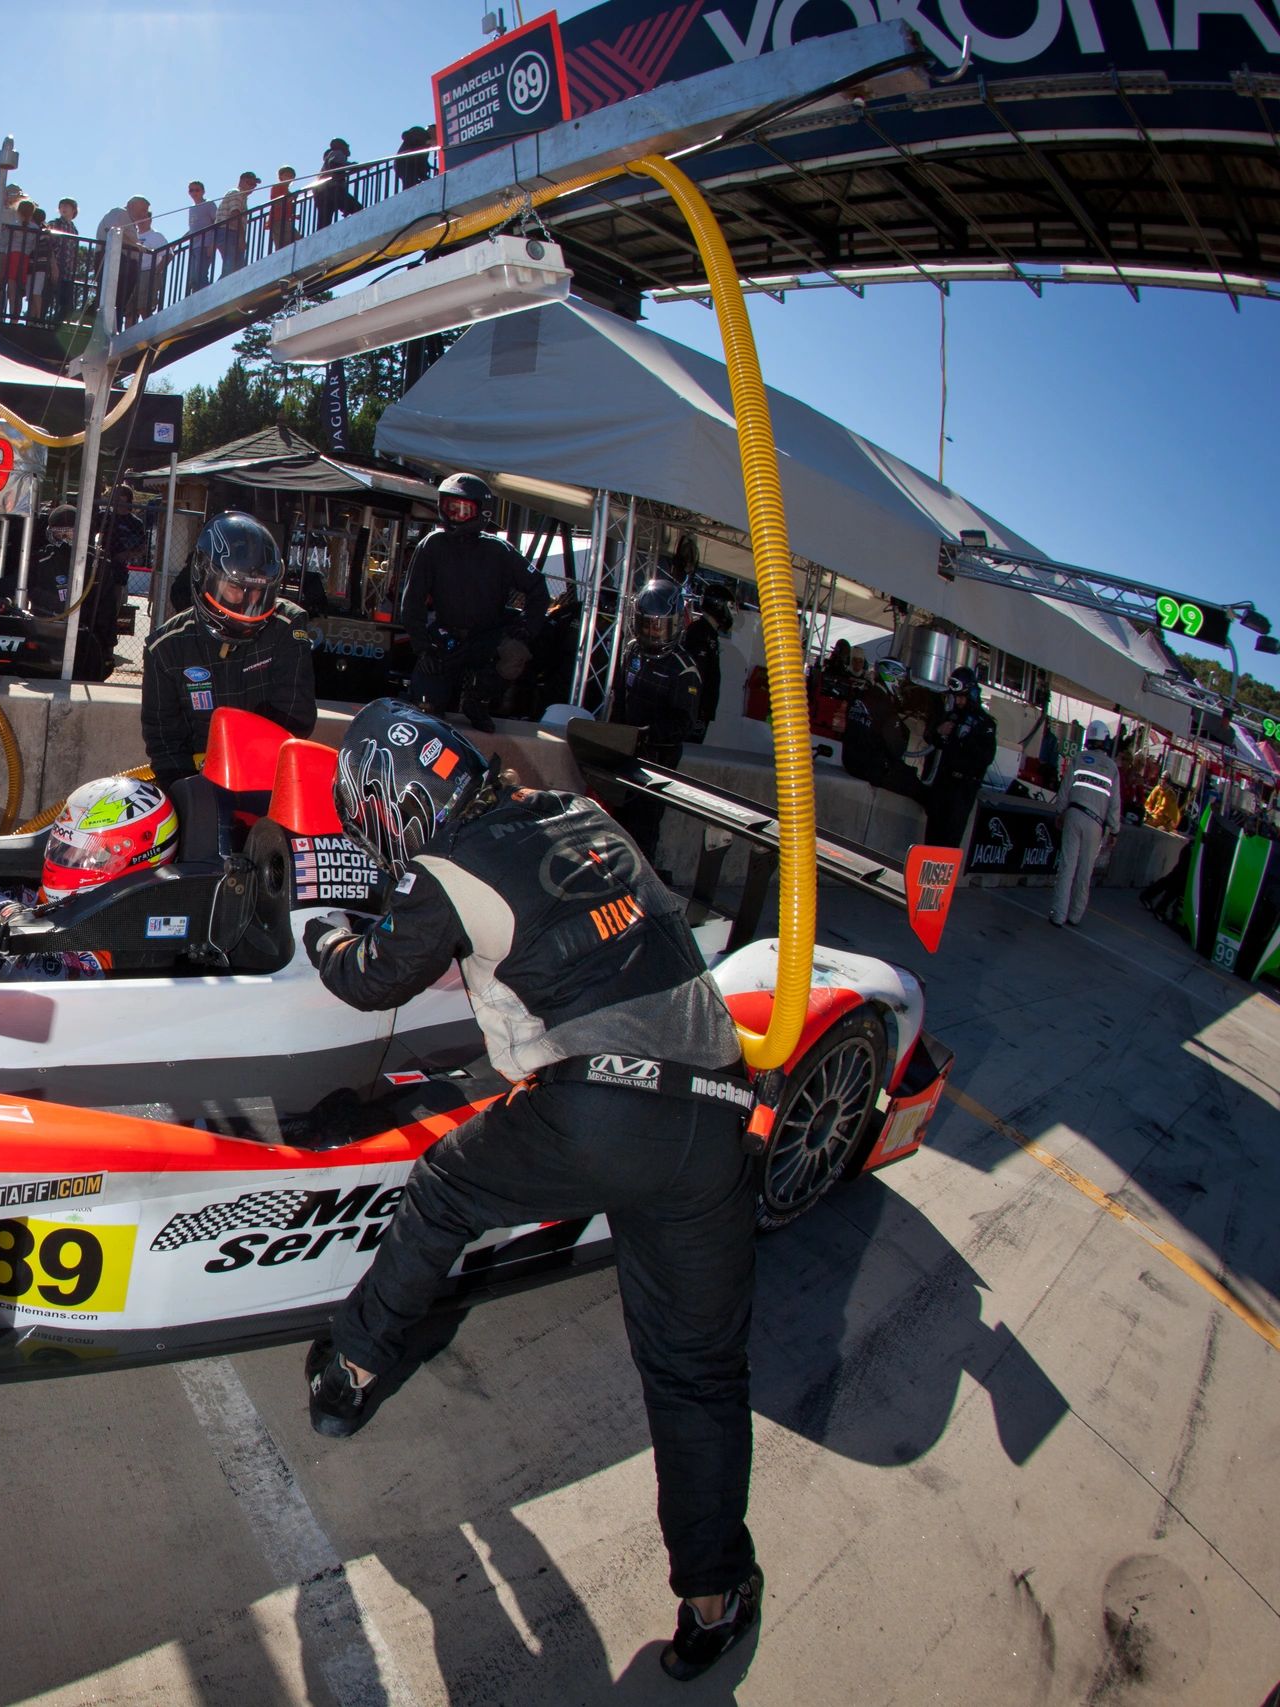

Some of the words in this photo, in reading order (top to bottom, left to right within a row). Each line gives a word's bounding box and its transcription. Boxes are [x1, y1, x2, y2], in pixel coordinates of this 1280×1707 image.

[452, 63, 505, 100] MARCELLI
[513, 62, 543, 105] 89
[457, 83, 499, 114] DUCOTE
[459, 99, 500, 129] DUCOTE
[460, 116, 494, 142] DRISSI
[330, 375, 346, 450] JAGUAR
[1156, 596, 1204, 637] 99
[327, 623, 385, 643] Lenco
[324, 640, 385, 660] Mobile
[392, 724, 413, 743] 37
[970, 843, 1008, 867] JAGUAR
[1020, 848, 1050, 869] JAGUAR
[318, 868, 378, 884] DUCOTE
[917, 860, 955, 886] MUSCLE
[320, 884, 369, 899] DRISSI
[587, 1070, 632, 1086] MECHANIX
[633, 1078, 658, 1090] WEAR
